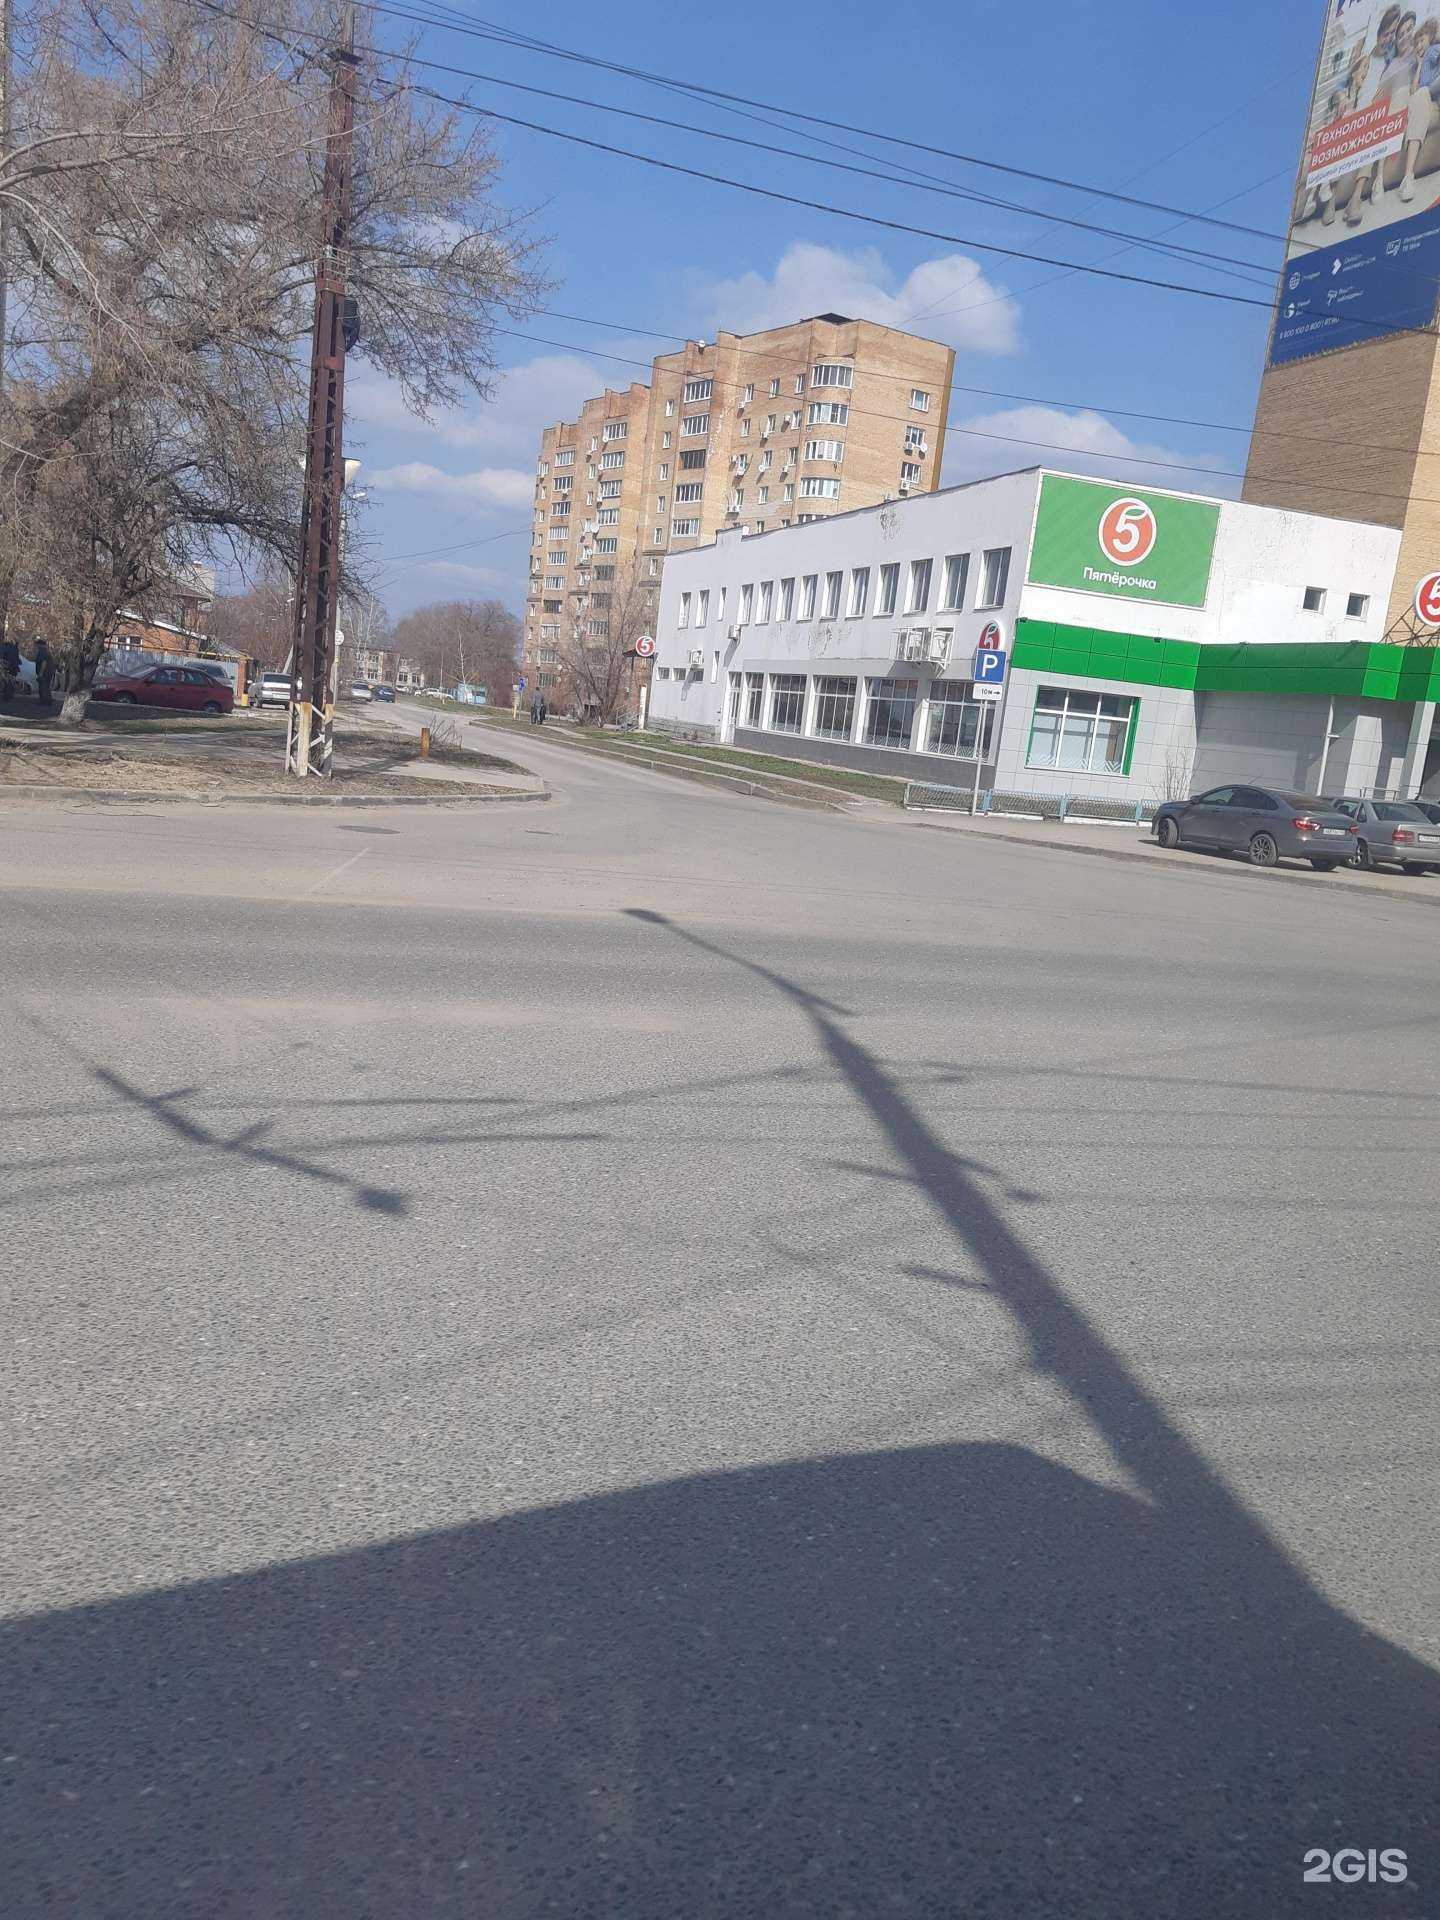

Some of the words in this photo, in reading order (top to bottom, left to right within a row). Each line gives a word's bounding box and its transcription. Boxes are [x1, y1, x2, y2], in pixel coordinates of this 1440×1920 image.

[1311, 114, 1404, 167] возможностей
[1316, 105, 1387, 147] Технологии
[1112, 505, 1149, 553] 5
[1083, 566, 1157, 590] Пятёрочка
[981, 653, 999, 678] P
